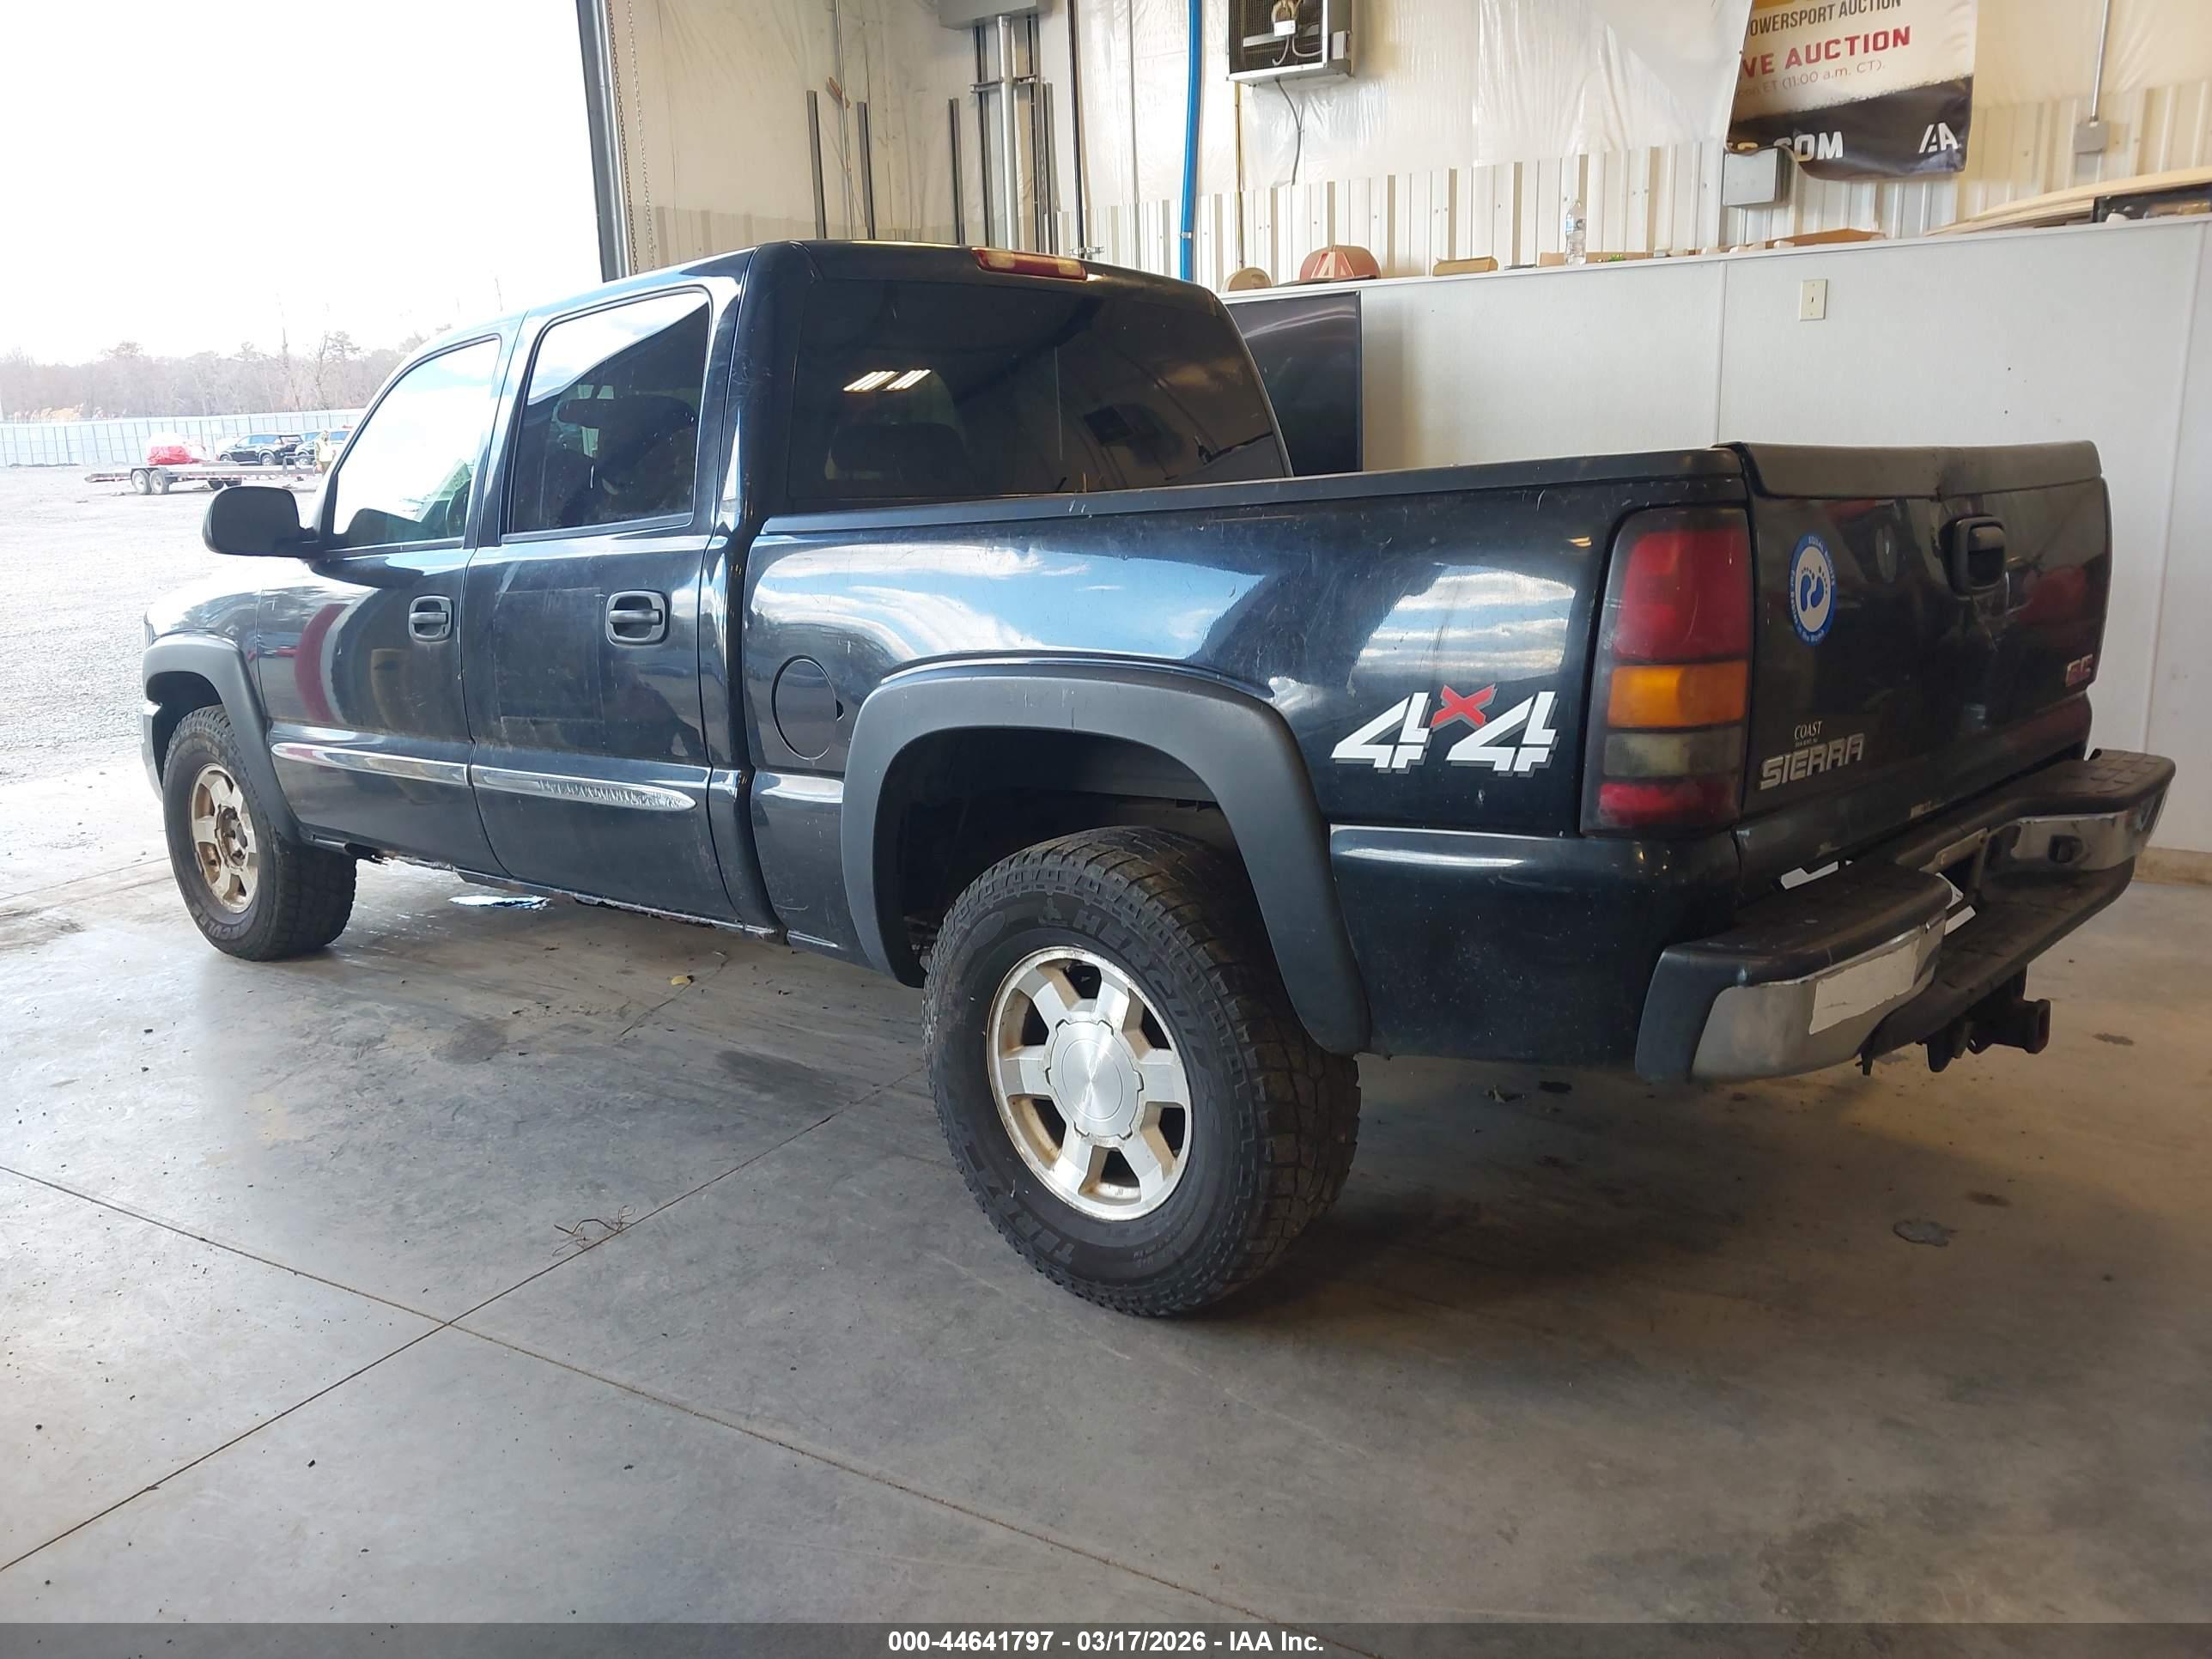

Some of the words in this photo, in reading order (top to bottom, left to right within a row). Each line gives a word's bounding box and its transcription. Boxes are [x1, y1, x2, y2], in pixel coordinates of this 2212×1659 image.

[1784, 25, 1911, 70] AUCTION
[1782, 70, 1819, 91] (11:00
[1822, 66, 1852, 81] a.m.
[1794, 720, 1823, 740] COAST
[1759, 732, 1865, 791] SIERRA
